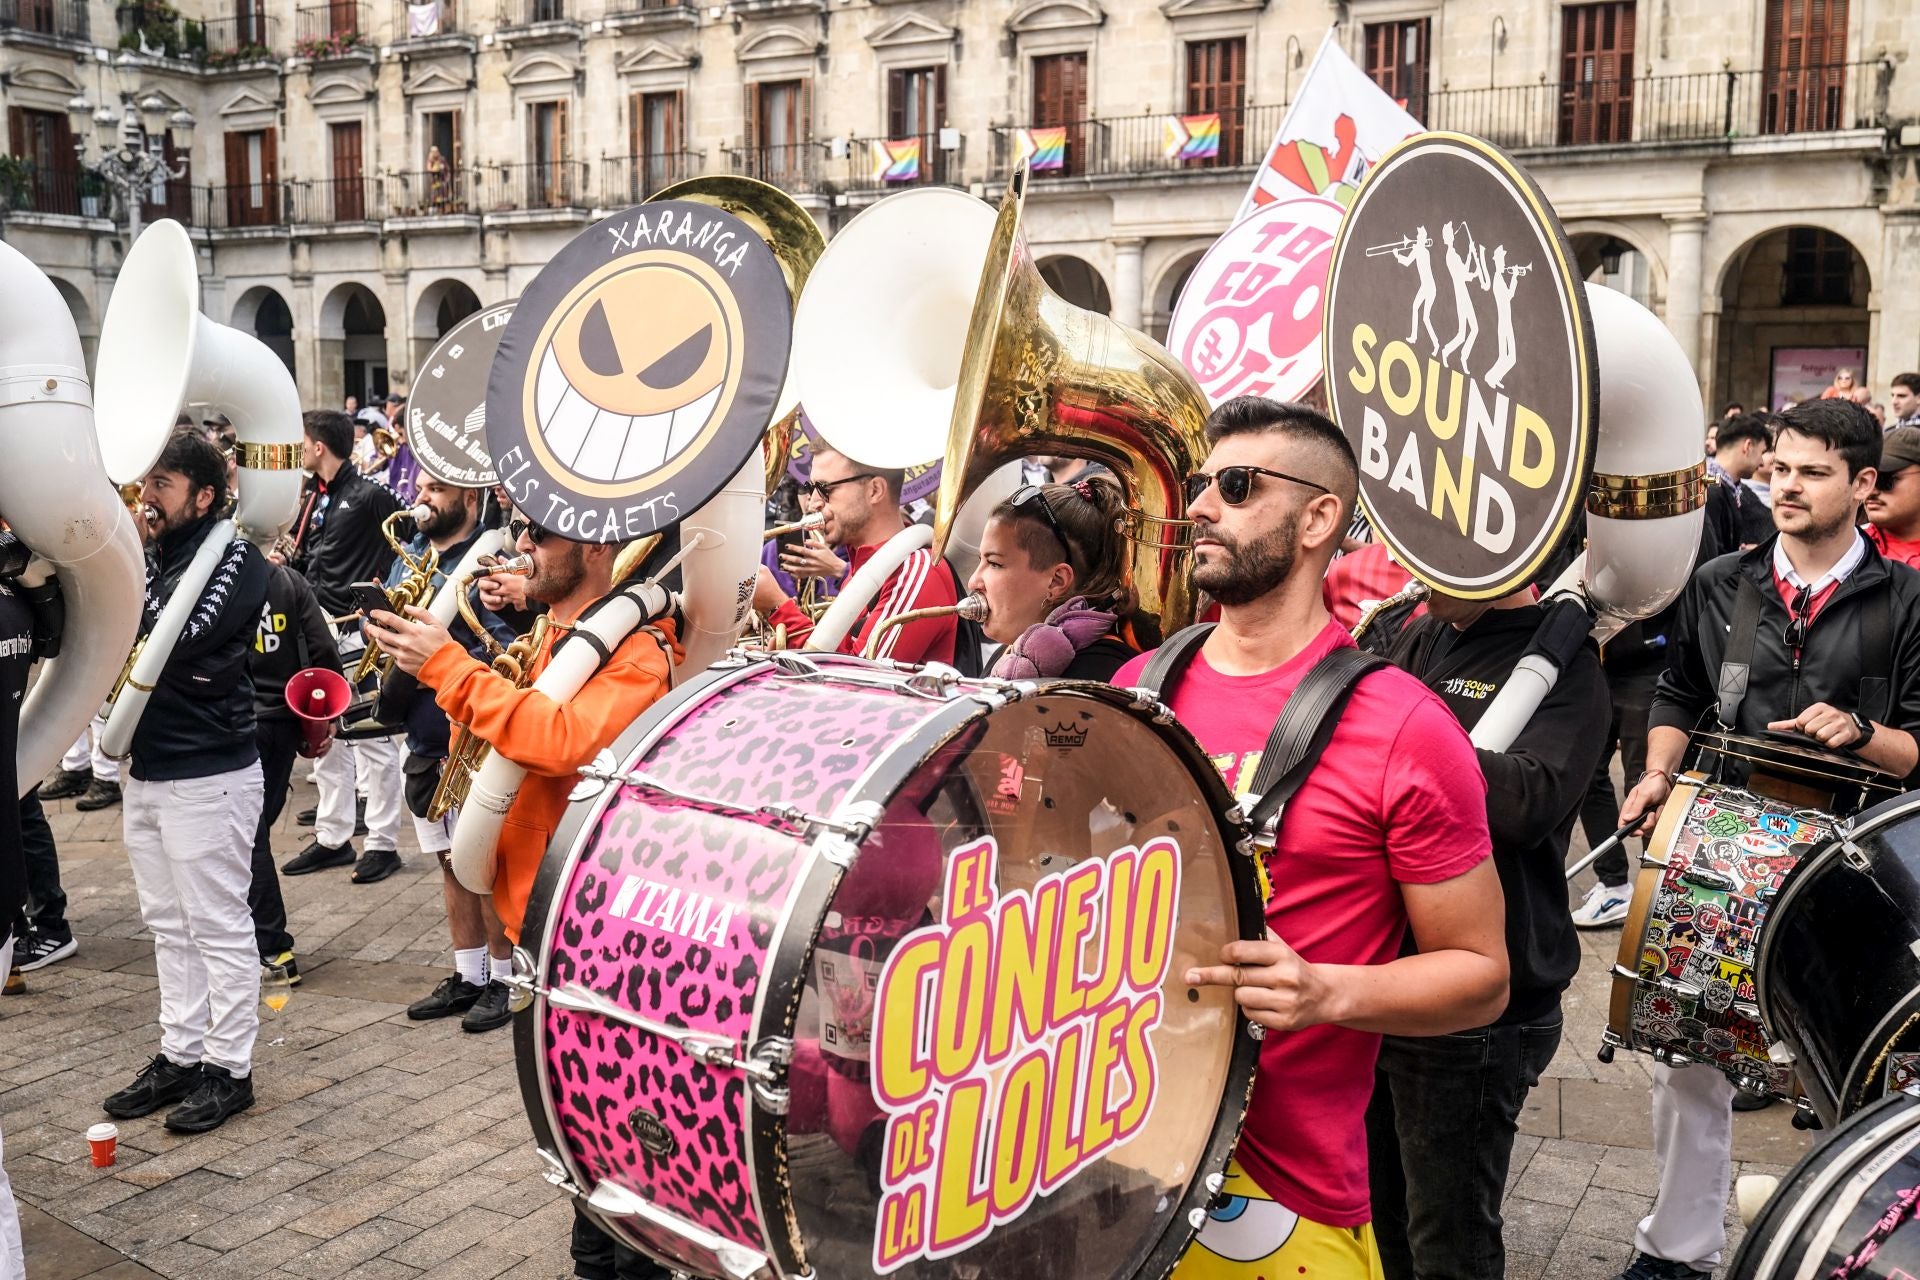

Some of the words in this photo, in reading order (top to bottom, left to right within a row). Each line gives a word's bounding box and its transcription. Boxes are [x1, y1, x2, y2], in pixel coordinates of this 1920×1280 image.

[608, 210, 750, 278] XARANGA
[1252, 222, 1334, 263] TO
[1204, 262, 1282, 306] CO
[426, 411, 458, 442] Aranda
[454, 433, 469, 450] de
[1349, 323, 1555, 489] SOUND
[498, 445, 540, 504] ELS
[541, 490, 681, 544] TOCAETS
[1360, 406, 1516, 554] BAND
[1461, 688, 1487, 699] BAND
[1464, 680, 1496, 692] SOUND
[1050, 735, 1081, 744] REMO
[625, 877, 738, 948] TAMA
[951, 846, 992, 923] EL
[878, 845, 1175, 1099] CONEJO
[880, 1187, 922, 1264] LA
[932, 995, 1159, 1247] LOLES
[887, 1106, 936, 1181] DE
